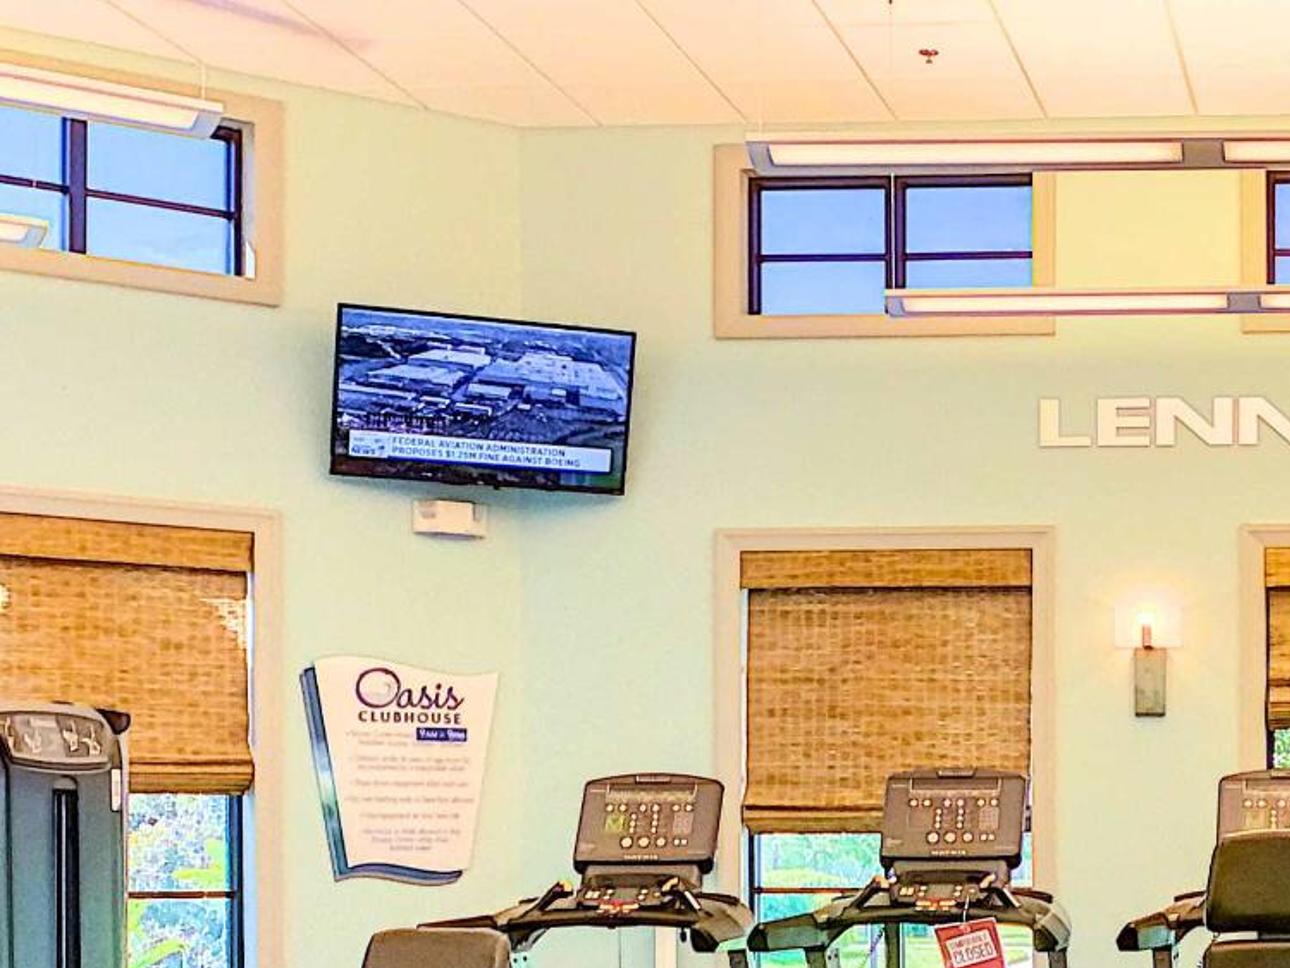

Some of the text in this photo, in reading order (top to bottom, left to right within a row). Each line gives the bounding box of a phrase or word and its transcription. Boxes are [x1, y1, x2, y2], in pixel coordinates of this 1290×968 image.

[391, 446, 442, 456] PROPOSES
[479, 453, 500, 462] FINE
[502, 454, 542, 464] AGAINST
[545, 457, 581, 467] BOEING
[392, 435, 566, 457] FEDERAL AVIATION ADMINISTRATION
[356, 667, 465, 710] Oasis
[358, 711, 461, 724] CLUBHOUSE
